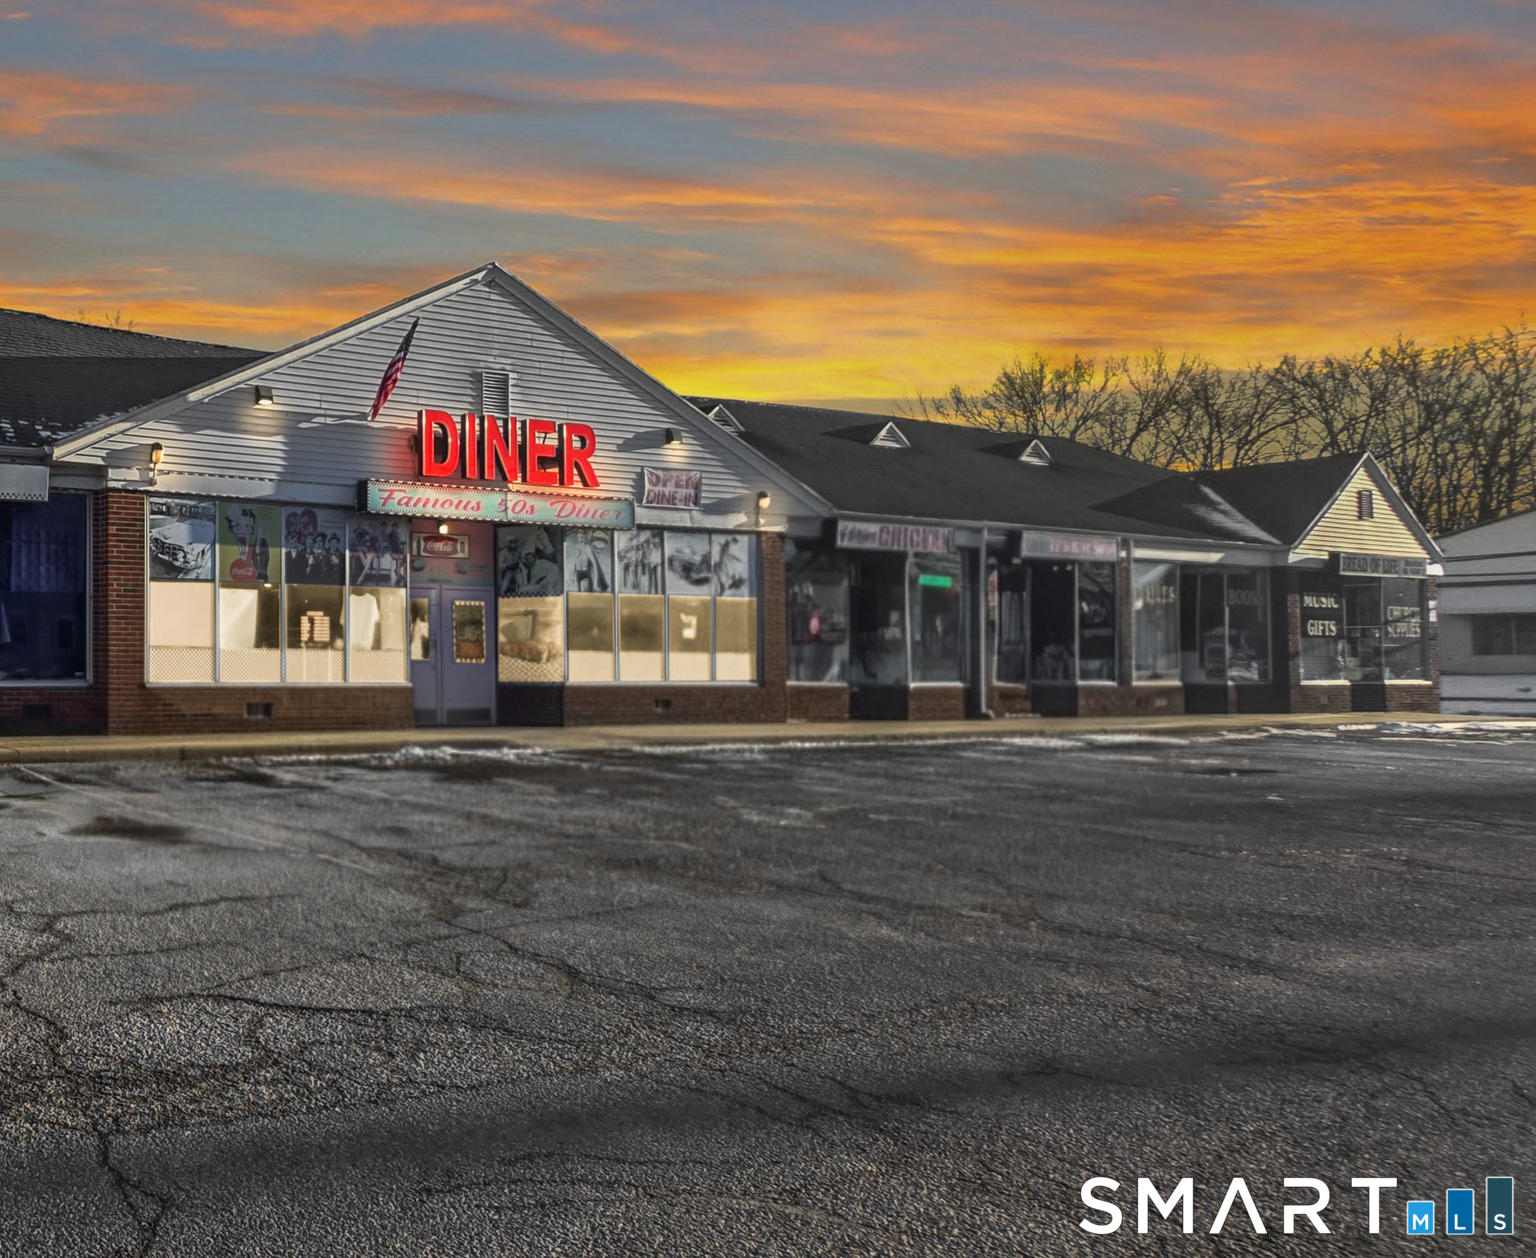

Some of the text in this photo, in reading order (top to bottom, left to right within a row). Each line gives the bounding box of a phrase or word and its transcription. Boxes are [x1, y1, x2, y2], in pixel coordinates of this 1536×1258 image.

[417, 408, 600, 488] DINER
[377, 487, 627, 521] Famous 50s Diner
[644, 489, 699, 508] DINE-IN
[1303, 593, 1339, 608] MUSIC
[1307, 620, 1337, 636] GIFTS
